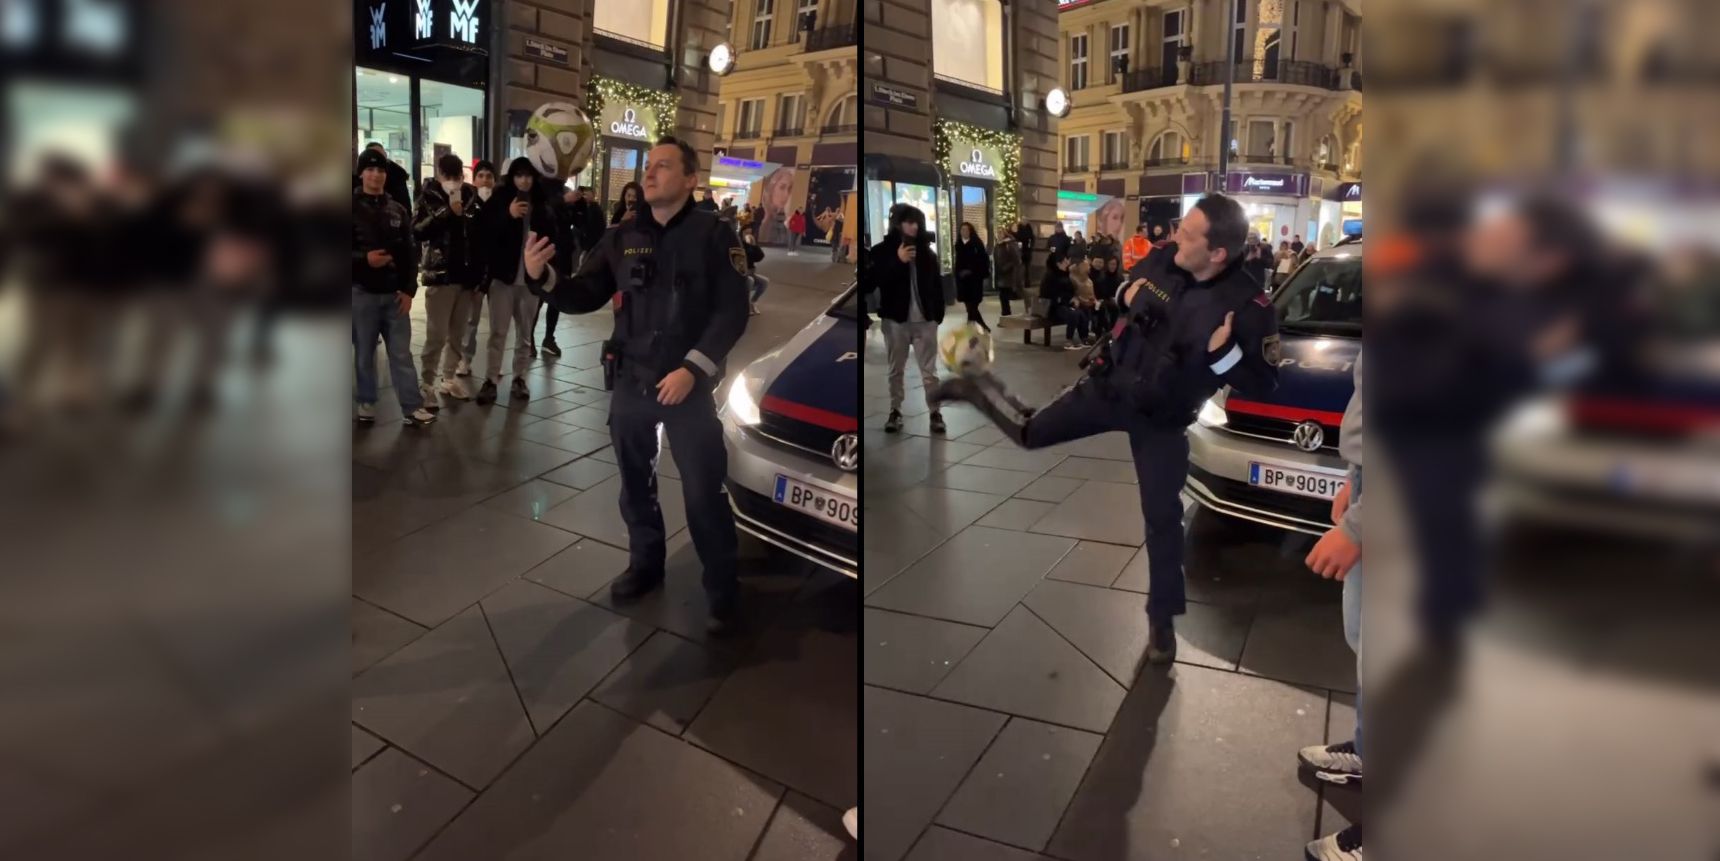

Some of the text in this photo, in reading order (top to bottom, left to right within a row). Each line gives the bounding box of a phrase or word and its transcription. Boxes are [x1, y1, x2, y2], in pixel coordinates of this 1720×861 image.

[611, 121, 648, 138] OMEGA
[960, 161, 995, 177] OMEGA
[624, 247, 653, 255] POLIZEI
[1265, 469, 1284, 486] BP
[791, 485, 814, 507] BP
